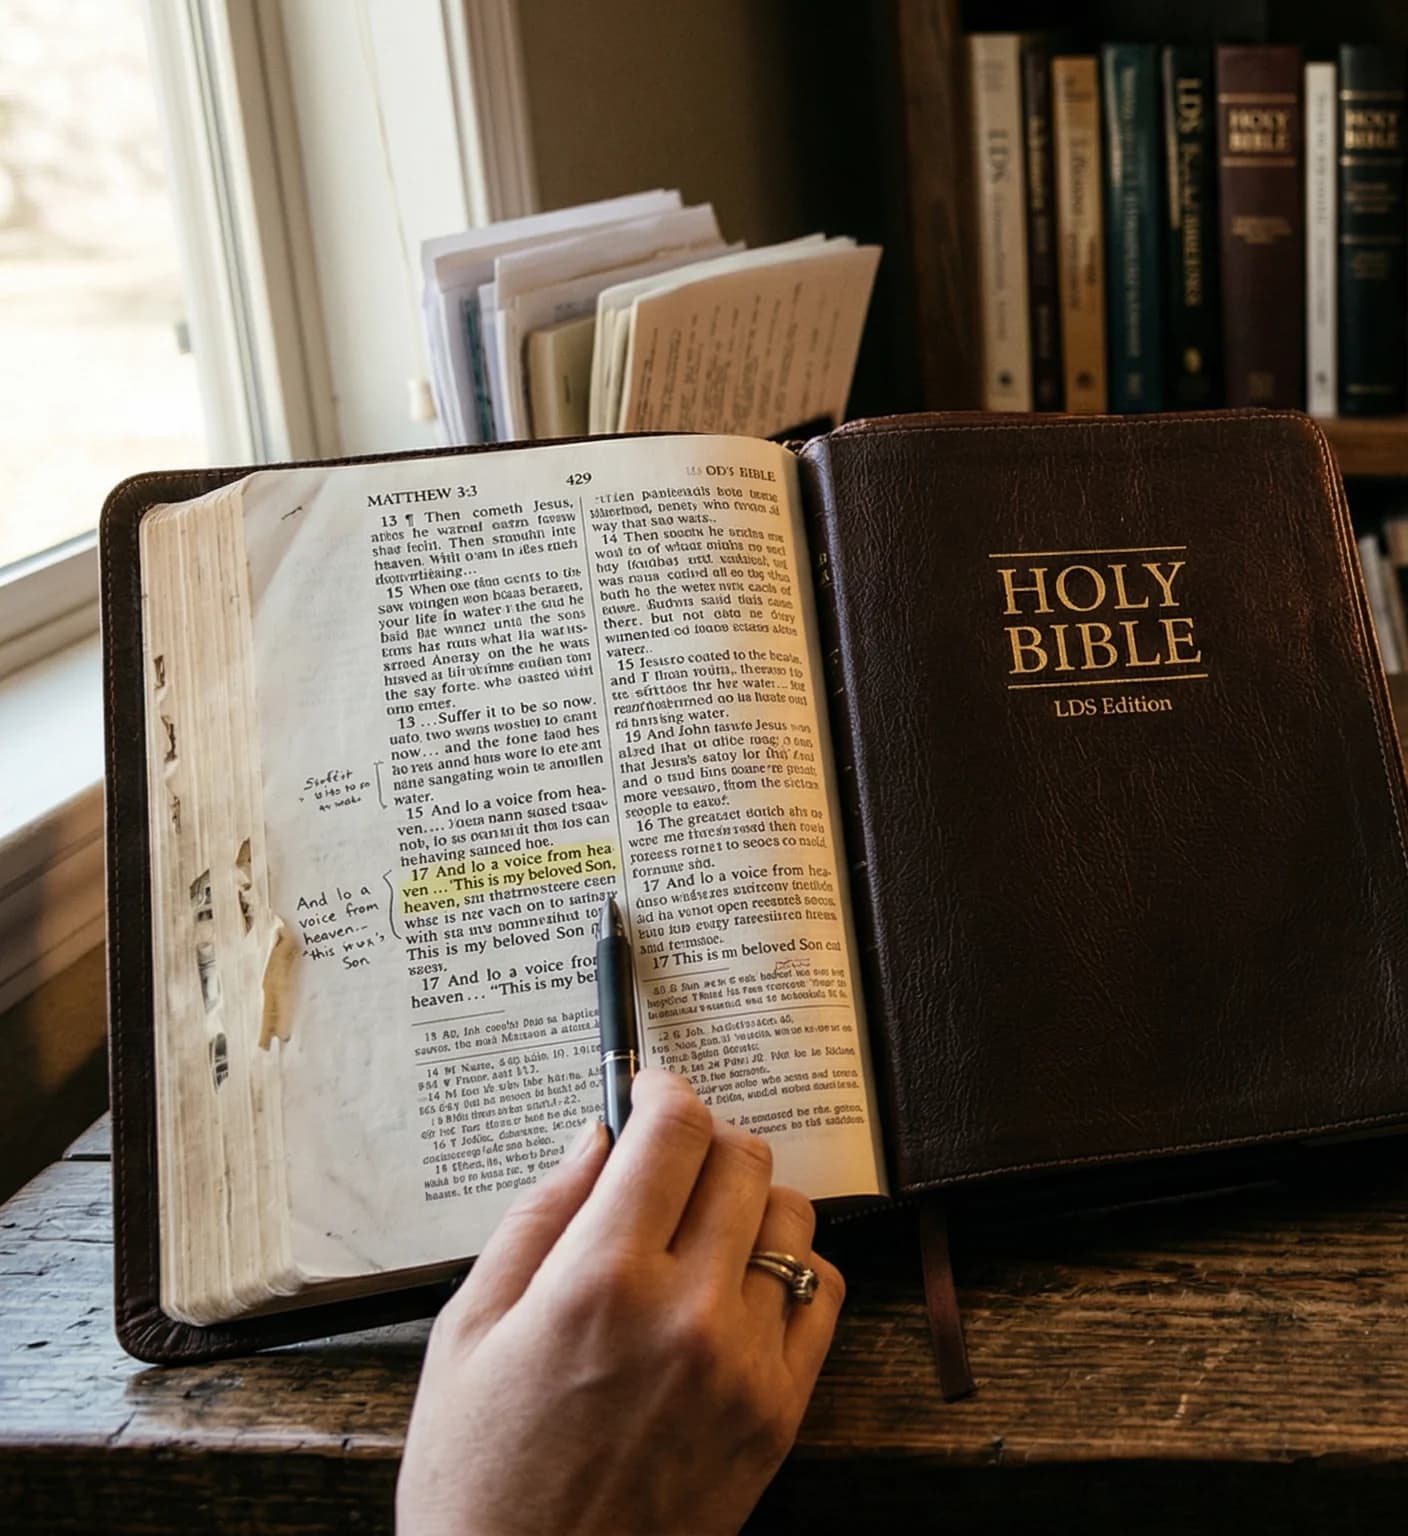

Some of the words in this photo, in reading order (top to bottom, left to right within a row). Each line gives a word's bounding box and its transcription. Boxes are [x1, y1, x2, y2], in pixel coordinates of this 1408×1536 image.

[1178, 79, 1201, 134] LDS
[1229, 110, 1289, 129] HOLY
[1345, 111, 1399, 128] HOLY
[1229, 132, 1286, 151] BIBLE
[1345, 130, 1398, 148] BIBLE
[566, 473, 591, 485] 429
[368, 488, 451, 507] MATTHEW
[458, 486, 477, 497] 3:3
[382, 515, 397, 527] 13
[424, 512, 460, 522] Then
[473, 503, 522, 518] cometh
[534, 500, 573, 512] Jesus,
[603, 534, 617, 544] 14
[623, 531, 658, 542] Then
[997, 561, 1185, 614] HOLY
[1004, 618, 1201, 674] BIBLE
[398, 716, 415, 729] 13
[487, 706, 496, 718] it
[501, 707, 515, 716] to
[521, 702, 536, 713] be
[543, 702, 557, 711] so
[564, 697, 596, 708] now.
[1054, 699, 1096, 717] LDS
[1102, 696, 1172, 714] Edition
[445, 739, 470, 753] and
[478, 737, 499, 749] the
[638, 819, 653, 832] 16
[657, 817, 683, 828] The
[412, 868, 428, 881] 17
[436, 863, 465, 878] And
[472, 861, 485, 872] lo
[492, 861, 498, 870] a
[504, 853, 542, 867] voice
[548, 850, 581, 862] from
[488, 874, 499, 886] is
[504, 873, 524, 888] my
[528, 862, 582, 880] beloved
[586, 860, 616, 872] Son,
[644, 879, 659, 892] 17
[667, 874, 695, 889] And
[700, 872, 713, 884] lo
[719, 873, 726, 881] a
[732, 866, 767, 879] voice
[773, 864, 803, 876] from
[297, 892, 327, 910] And
[337, 888, 352, 900] lo
[361, 887, 370, 895] a
[404, 898, 459, 913] heaven,
[299, 913, 336, 928] voice
[346, 903, 379, 917] from
[406, 945, 439, 960] This
[446, 943, 458, 955] is
[465, 941, 486, 954] my
[493, 928, 549, 948] beloved
[557, 927, 584, 939] Son
[653, 955, 669, 968] 17
[672, 950, 703, 965] This
[707, 948, 718, 960] is
[742, 939, 796, 955] beloved
[800, 938, 822, 950] Son
[343, 956, 370, 969] Son
[423, 977, 439, 990] 17
[448, 970, 478, 987] And
[487, 969, 501, 981] lo
[509, 968, 517, 977] a
[525, 960, 563, 974] voice
[535, 977, 546, 990] is
[551, 976, 572, 989] my
